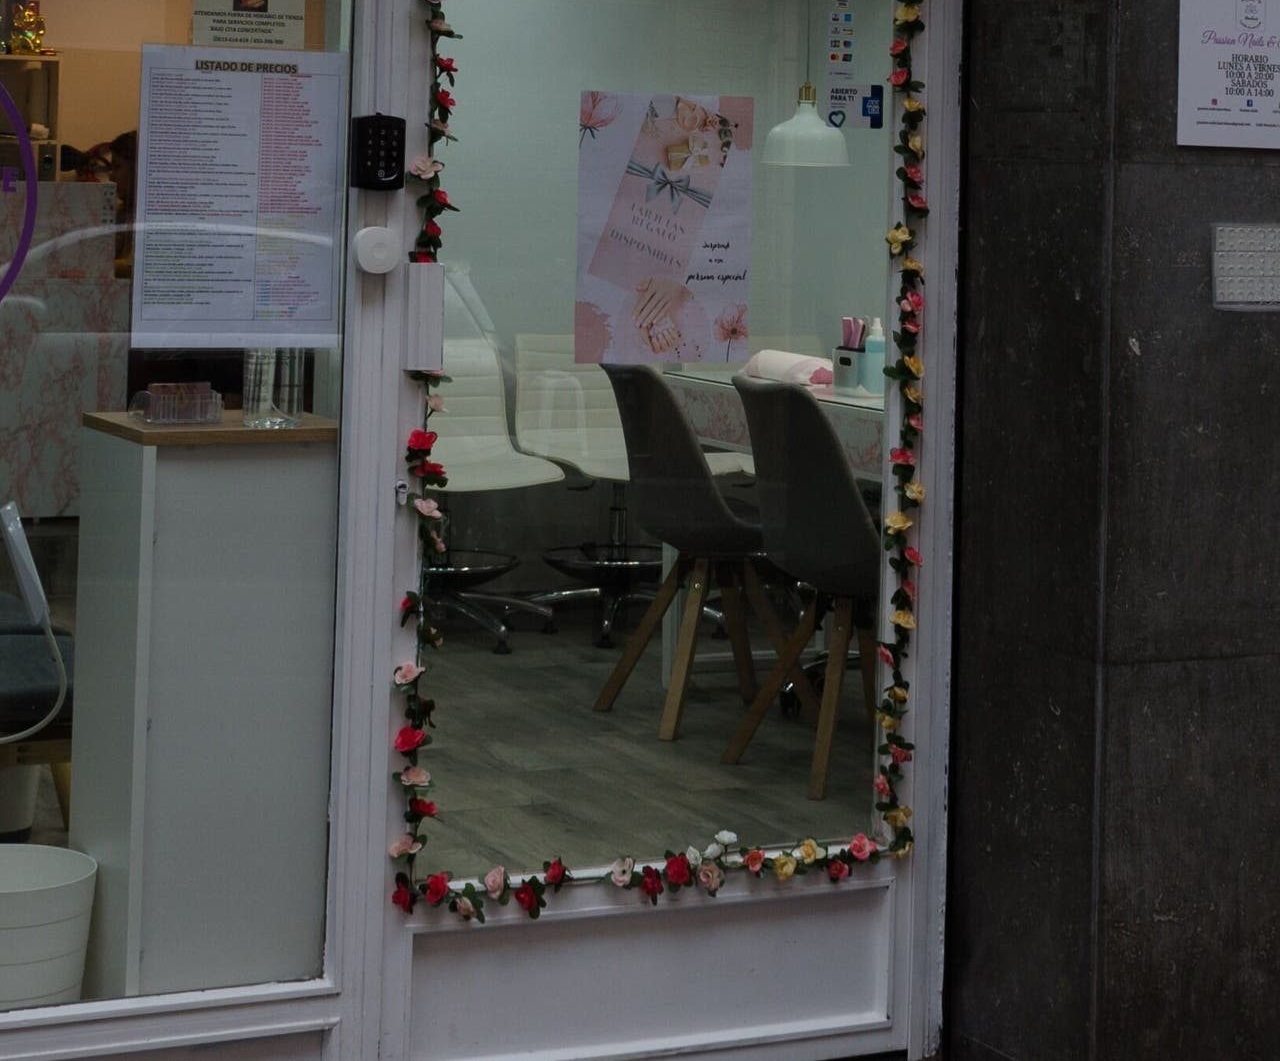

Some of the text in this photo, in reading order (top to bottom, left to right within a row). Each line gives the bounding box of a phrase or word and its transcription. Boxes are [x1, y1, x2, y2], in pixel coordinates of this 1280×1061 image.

[1201, 29, 1236, 46] Passion
[1238, 32, 1264, 49] Nails
[1231, 54, 1268, 64] HORARIO
[195, 60, 298, 74] LISTADO DE PRECIOS
[1218, 61, 1244, 71] LUNES
[1245, 63, 1252, 71] A
[1225, 71, 1245, 79] 10:00
[1254, 73, 1274, 81] 20:00
[1225, 87, 1274, 97] 10:00 A 14:00
[609, 228, 682, 269] DISPONIBLES
